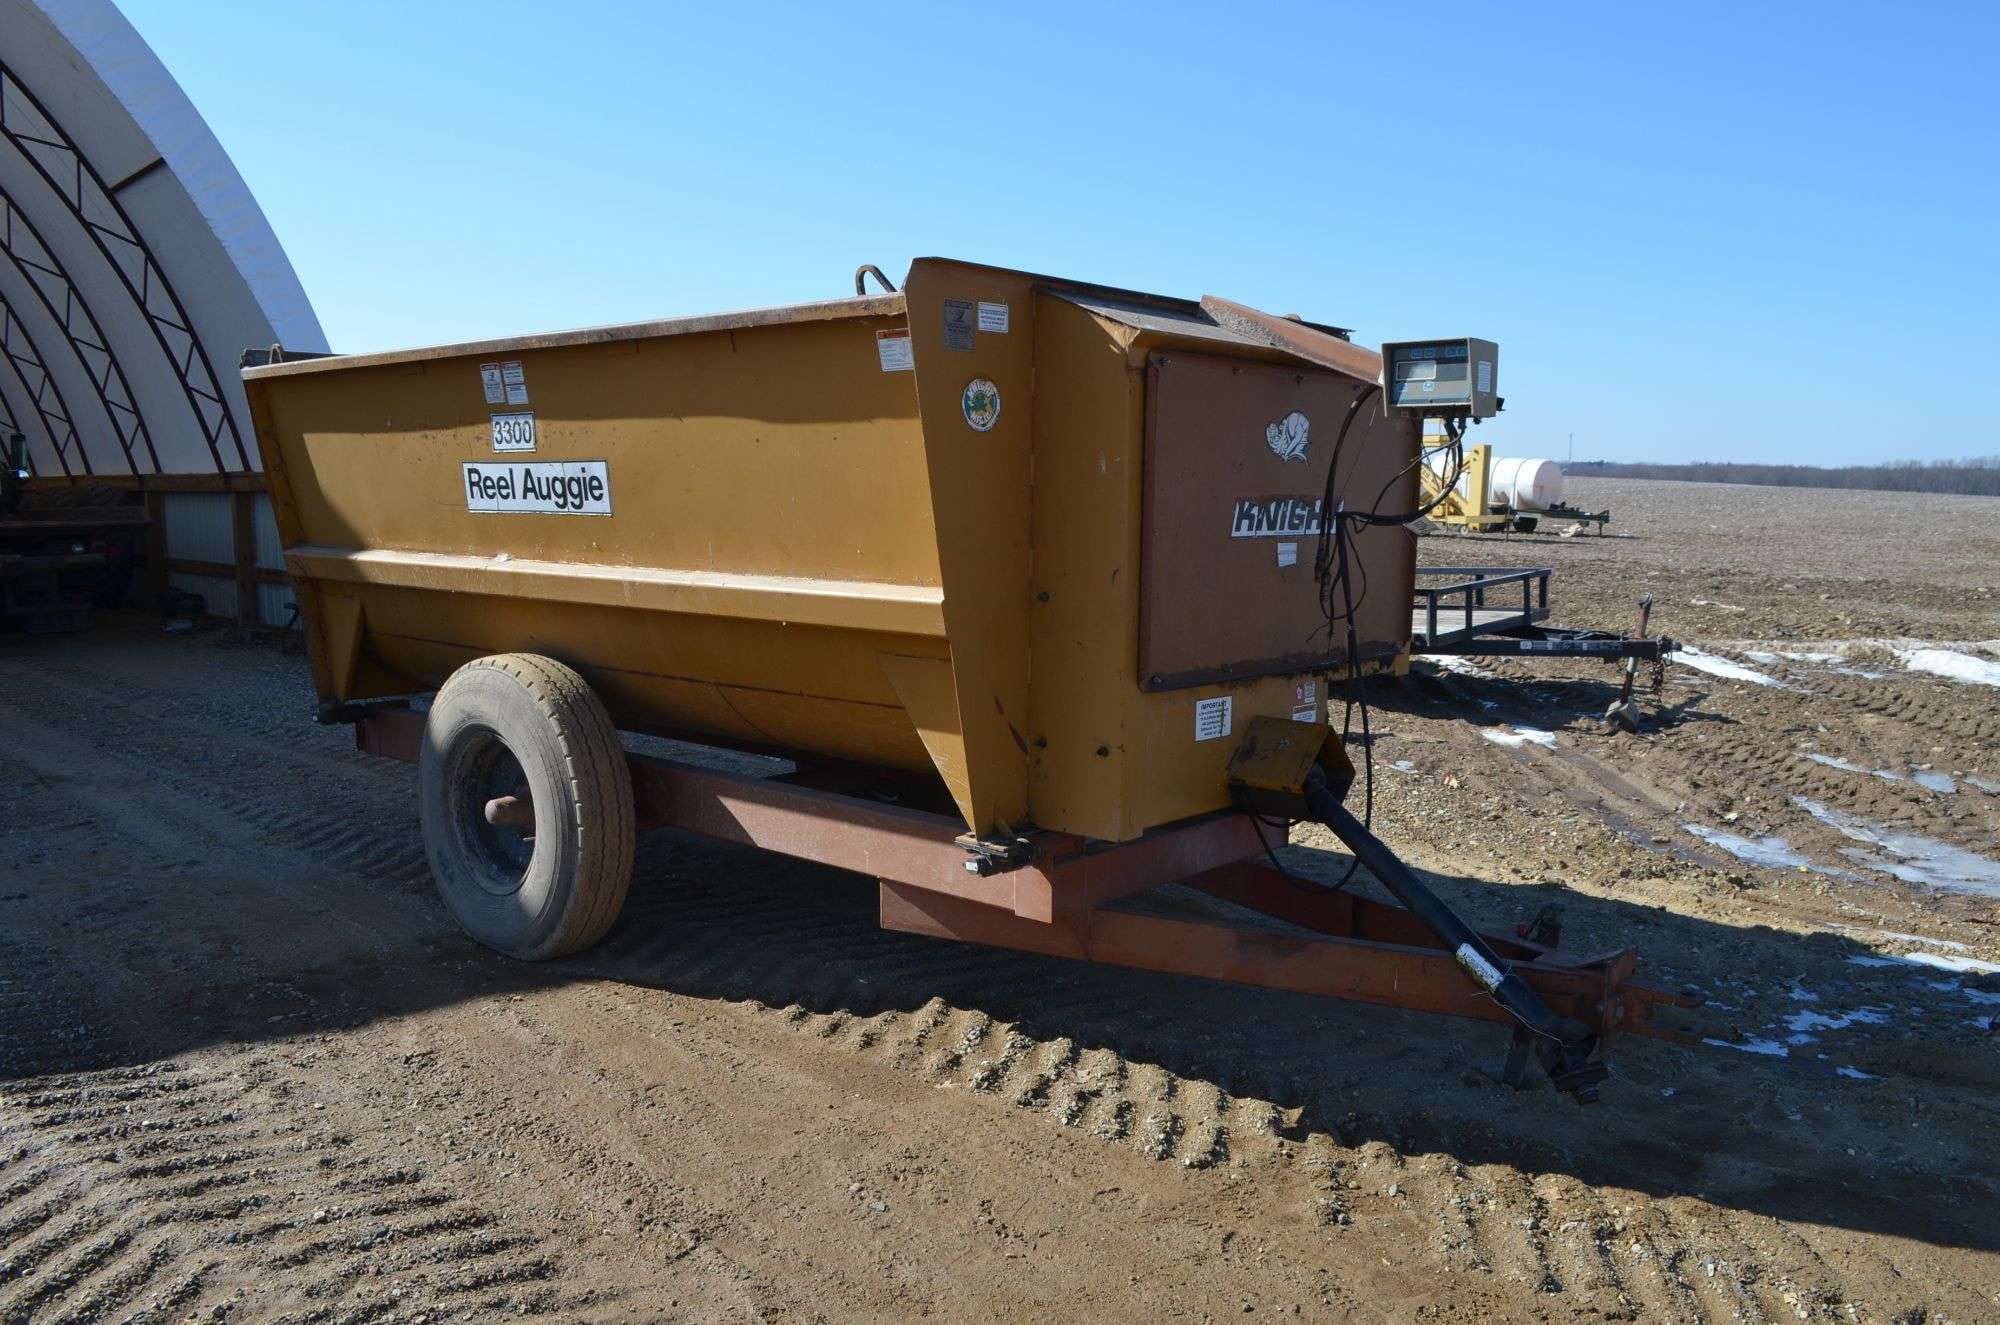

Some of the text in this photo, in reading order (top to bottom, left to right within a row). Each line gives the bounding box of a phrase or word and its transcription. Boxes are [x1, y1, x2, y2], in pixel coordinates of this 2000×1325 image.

[494, 420, 532, 445] 3300
[466, 466, 604, 510] Reel Auggie
